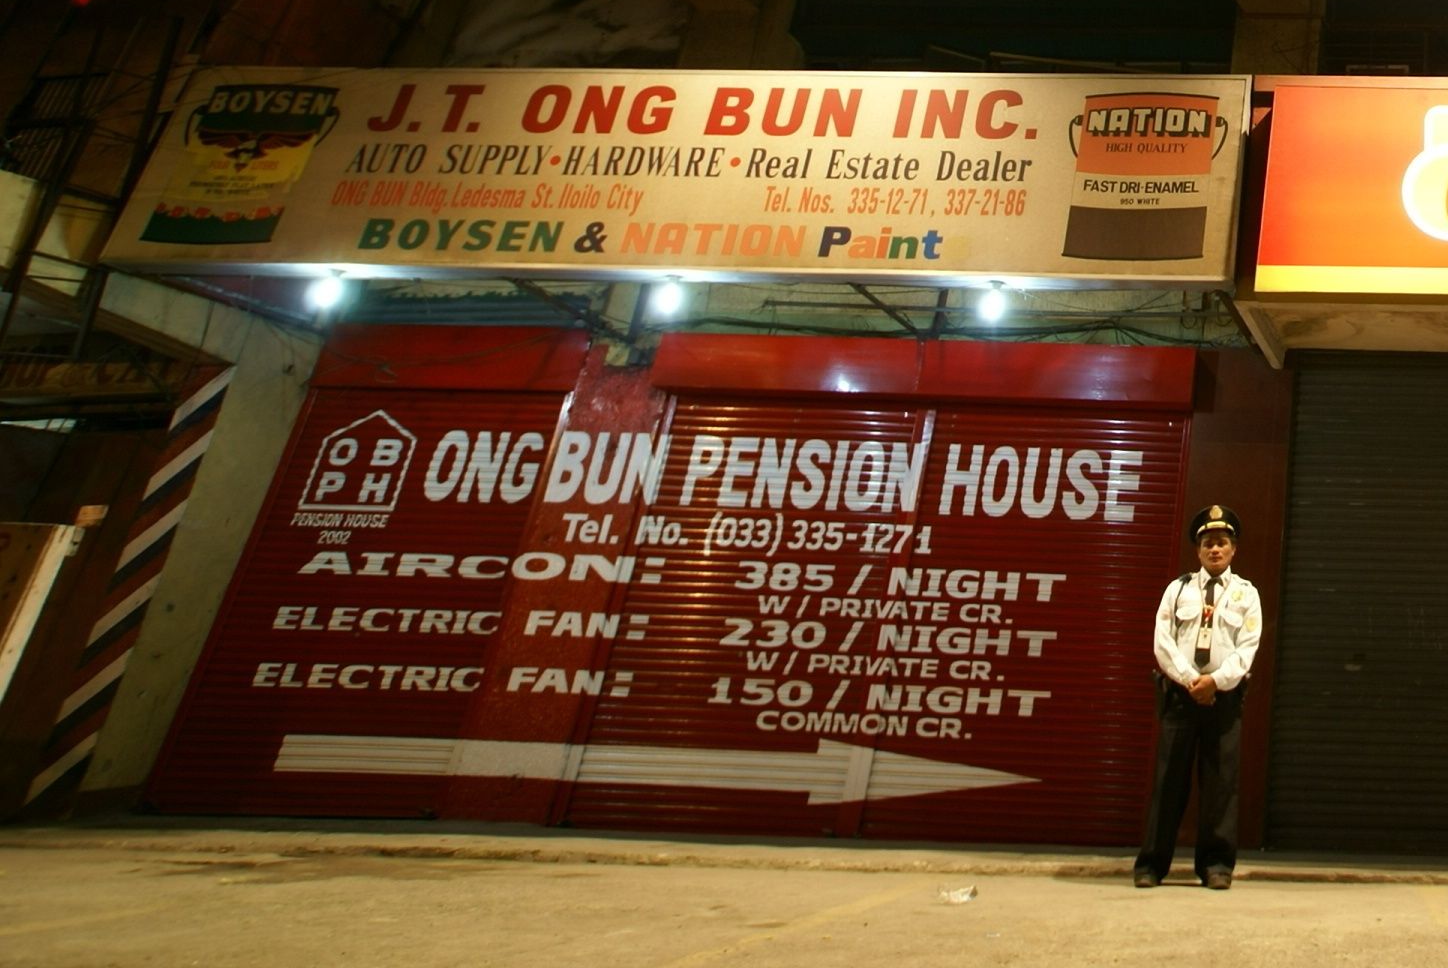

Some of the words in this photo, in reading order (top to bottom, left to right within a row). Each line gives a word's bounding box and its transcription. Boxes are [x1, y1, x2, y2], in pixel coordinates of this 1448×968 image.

[208, 89, 334, 116] BOYSEN
[367, 84, 487, 133] J.T.
[521, 85, 677, 135] ONG
[704, 87, 864, 139] BUN
[893, 89, 1038, 140] INC.
[1087, 107, 1210, 139] NATION
[346, 144, 428, 176] AUTO
[826, 148, 920, 180] Estate
[935, 150, 1034, 182] Dealer
[1106, 142, 1134, 154] HIGH
[1137, 142, 1188, 156] QUALITY
[332, 181, 368, 206] ONG
[370, 182, 404, 207] BUN
[451, 183, 525, 209] Ledesma
[530, 184, 556, 209] St.
[606, 186, 645, 216] City
[763, 186, 793, 214] Tel.
[797, 187, 836, 214] Nos.
[943, 188, 1028, 216] 337-21-86
[1082, 179, 1117, 194] FAST
[357, 218, 565, 253] BOYSEN
[572, 221, 609, 254] &
[619, 221, 808, 258] NATION
[423, 429, 545, 504] ONG
[543, 431, 674, 506] BUN
[680, 434, 929, 513] PENSION
[938, 443, 1145, 523] HOUSE
[290, 512, 341, 527] PENSION
[343, 513, 389, 529] HOUSE
[562, 512, 619, 546] Tel.
[634, 515, 689, 547] No.
[703, 511, 784, 557] (033)
[786, 518, 932, 555] 335-1271
[317, 529, 351, 545] 2002
[734, 560, 837, 594] 385
[886, 567, 1068, 603] NIGHT
[271, 605, 504, 635] ELECTRIC
[818, 595, 949, 622] PRIVATE
[959, 603, 1014, 625] CR.
[719, 617, 827, 651] 230
[876, 623, 1059, 658] NIGHT
[251, 662, 485, 693] ELECTRIC
[807, 652, 938, 680] PRIVATE
[948, 660, 1006, 683] CR.
[707, 676, 815, 709] 150
[865, 683, 1053, 718] NIGHT
[755, 710, 909, 737] COMMON
[915, 717, 973, 740] CR.
